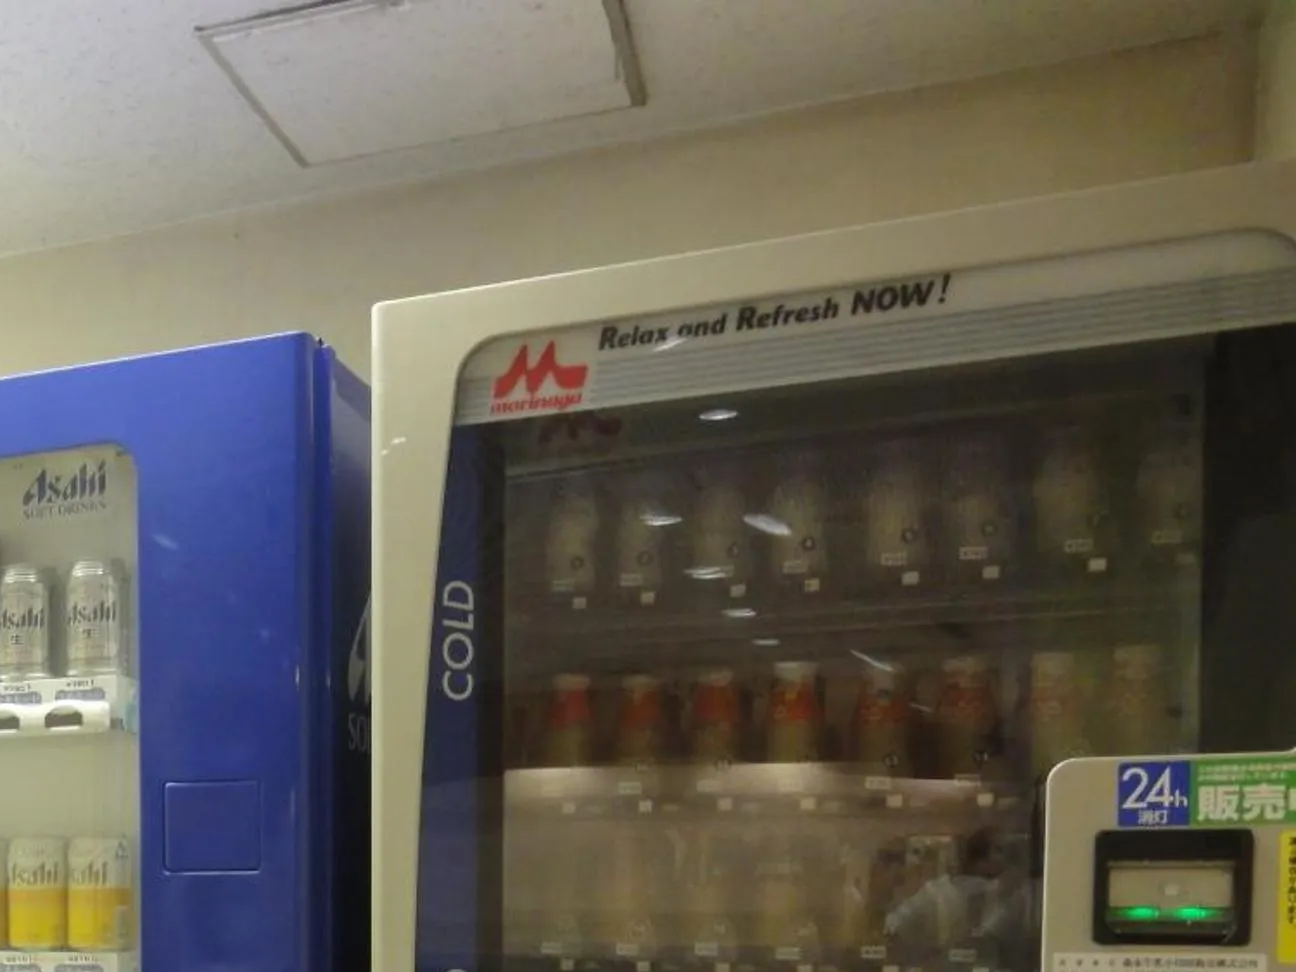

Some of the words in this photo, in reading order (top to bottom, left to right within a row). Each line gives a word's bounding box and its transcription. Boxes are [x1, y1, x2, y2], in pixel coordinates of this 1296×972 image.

[597, 324, 671, 351] Relax
[677, 312, 729, 339] and
[735, 296, 841, 333] Refresh
[489, 392, 583, 417] morinaga
[22, 458, 106, 506] Asahi
[67, 600, 117, 624] Asahi
[441, 579, 475, 701] COLD
[1122, 765, 1189, 809] 24h
